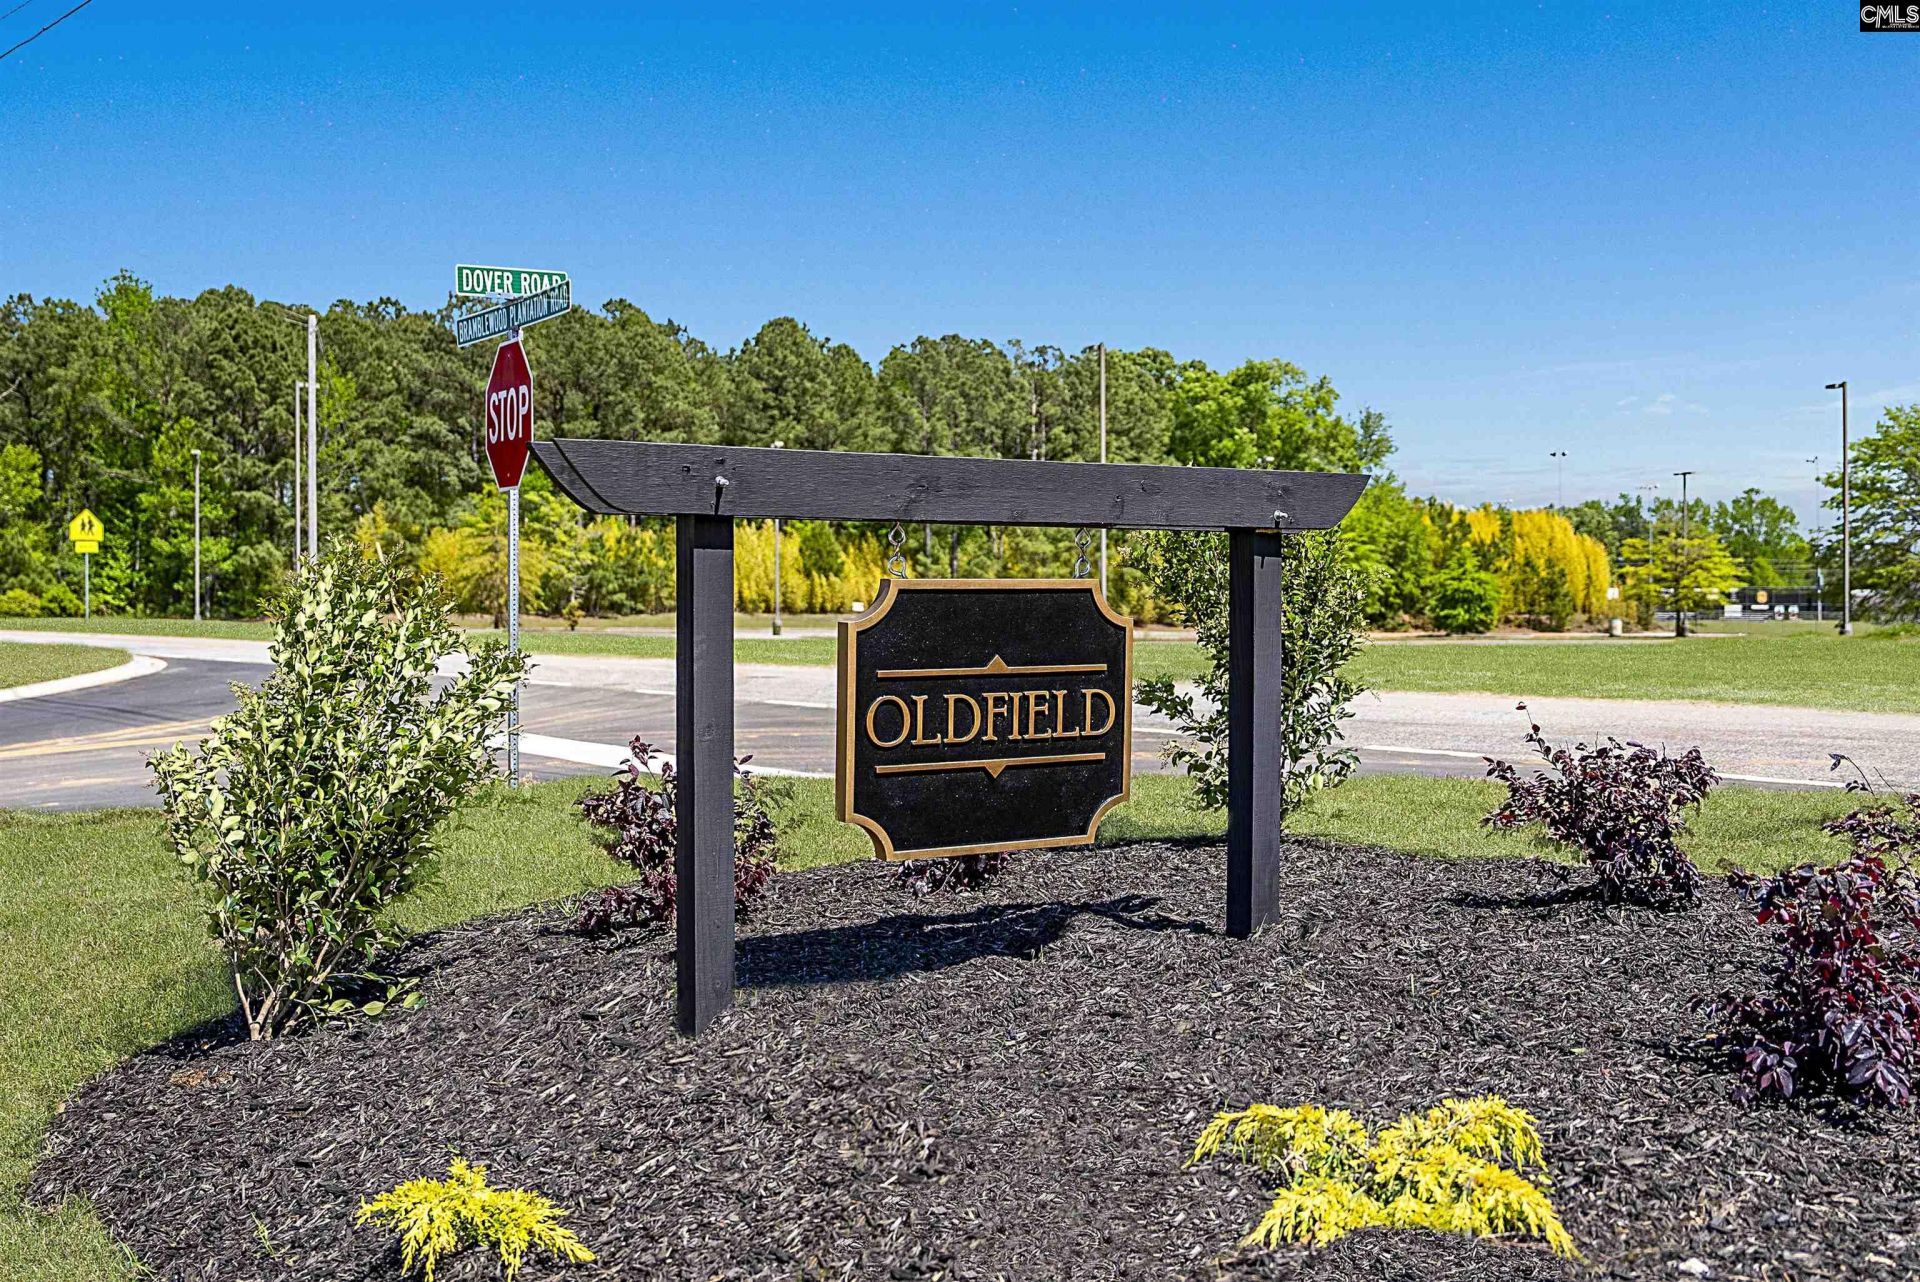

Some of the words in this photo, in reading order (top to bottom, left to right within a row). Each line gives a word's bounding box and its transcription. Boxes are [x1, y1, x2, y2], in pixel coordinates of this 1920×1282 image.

[462, 269, 513, 294] DOVER
[459, 307, 507, 342] BRAMBLEWOOD
[509, 294, 548, 326] PLANTATION
[550, 285, 568, 313] ROAD
[489, 384, 529, 444] STOP
[866, 688, 1116, 748] OLDFIELD
